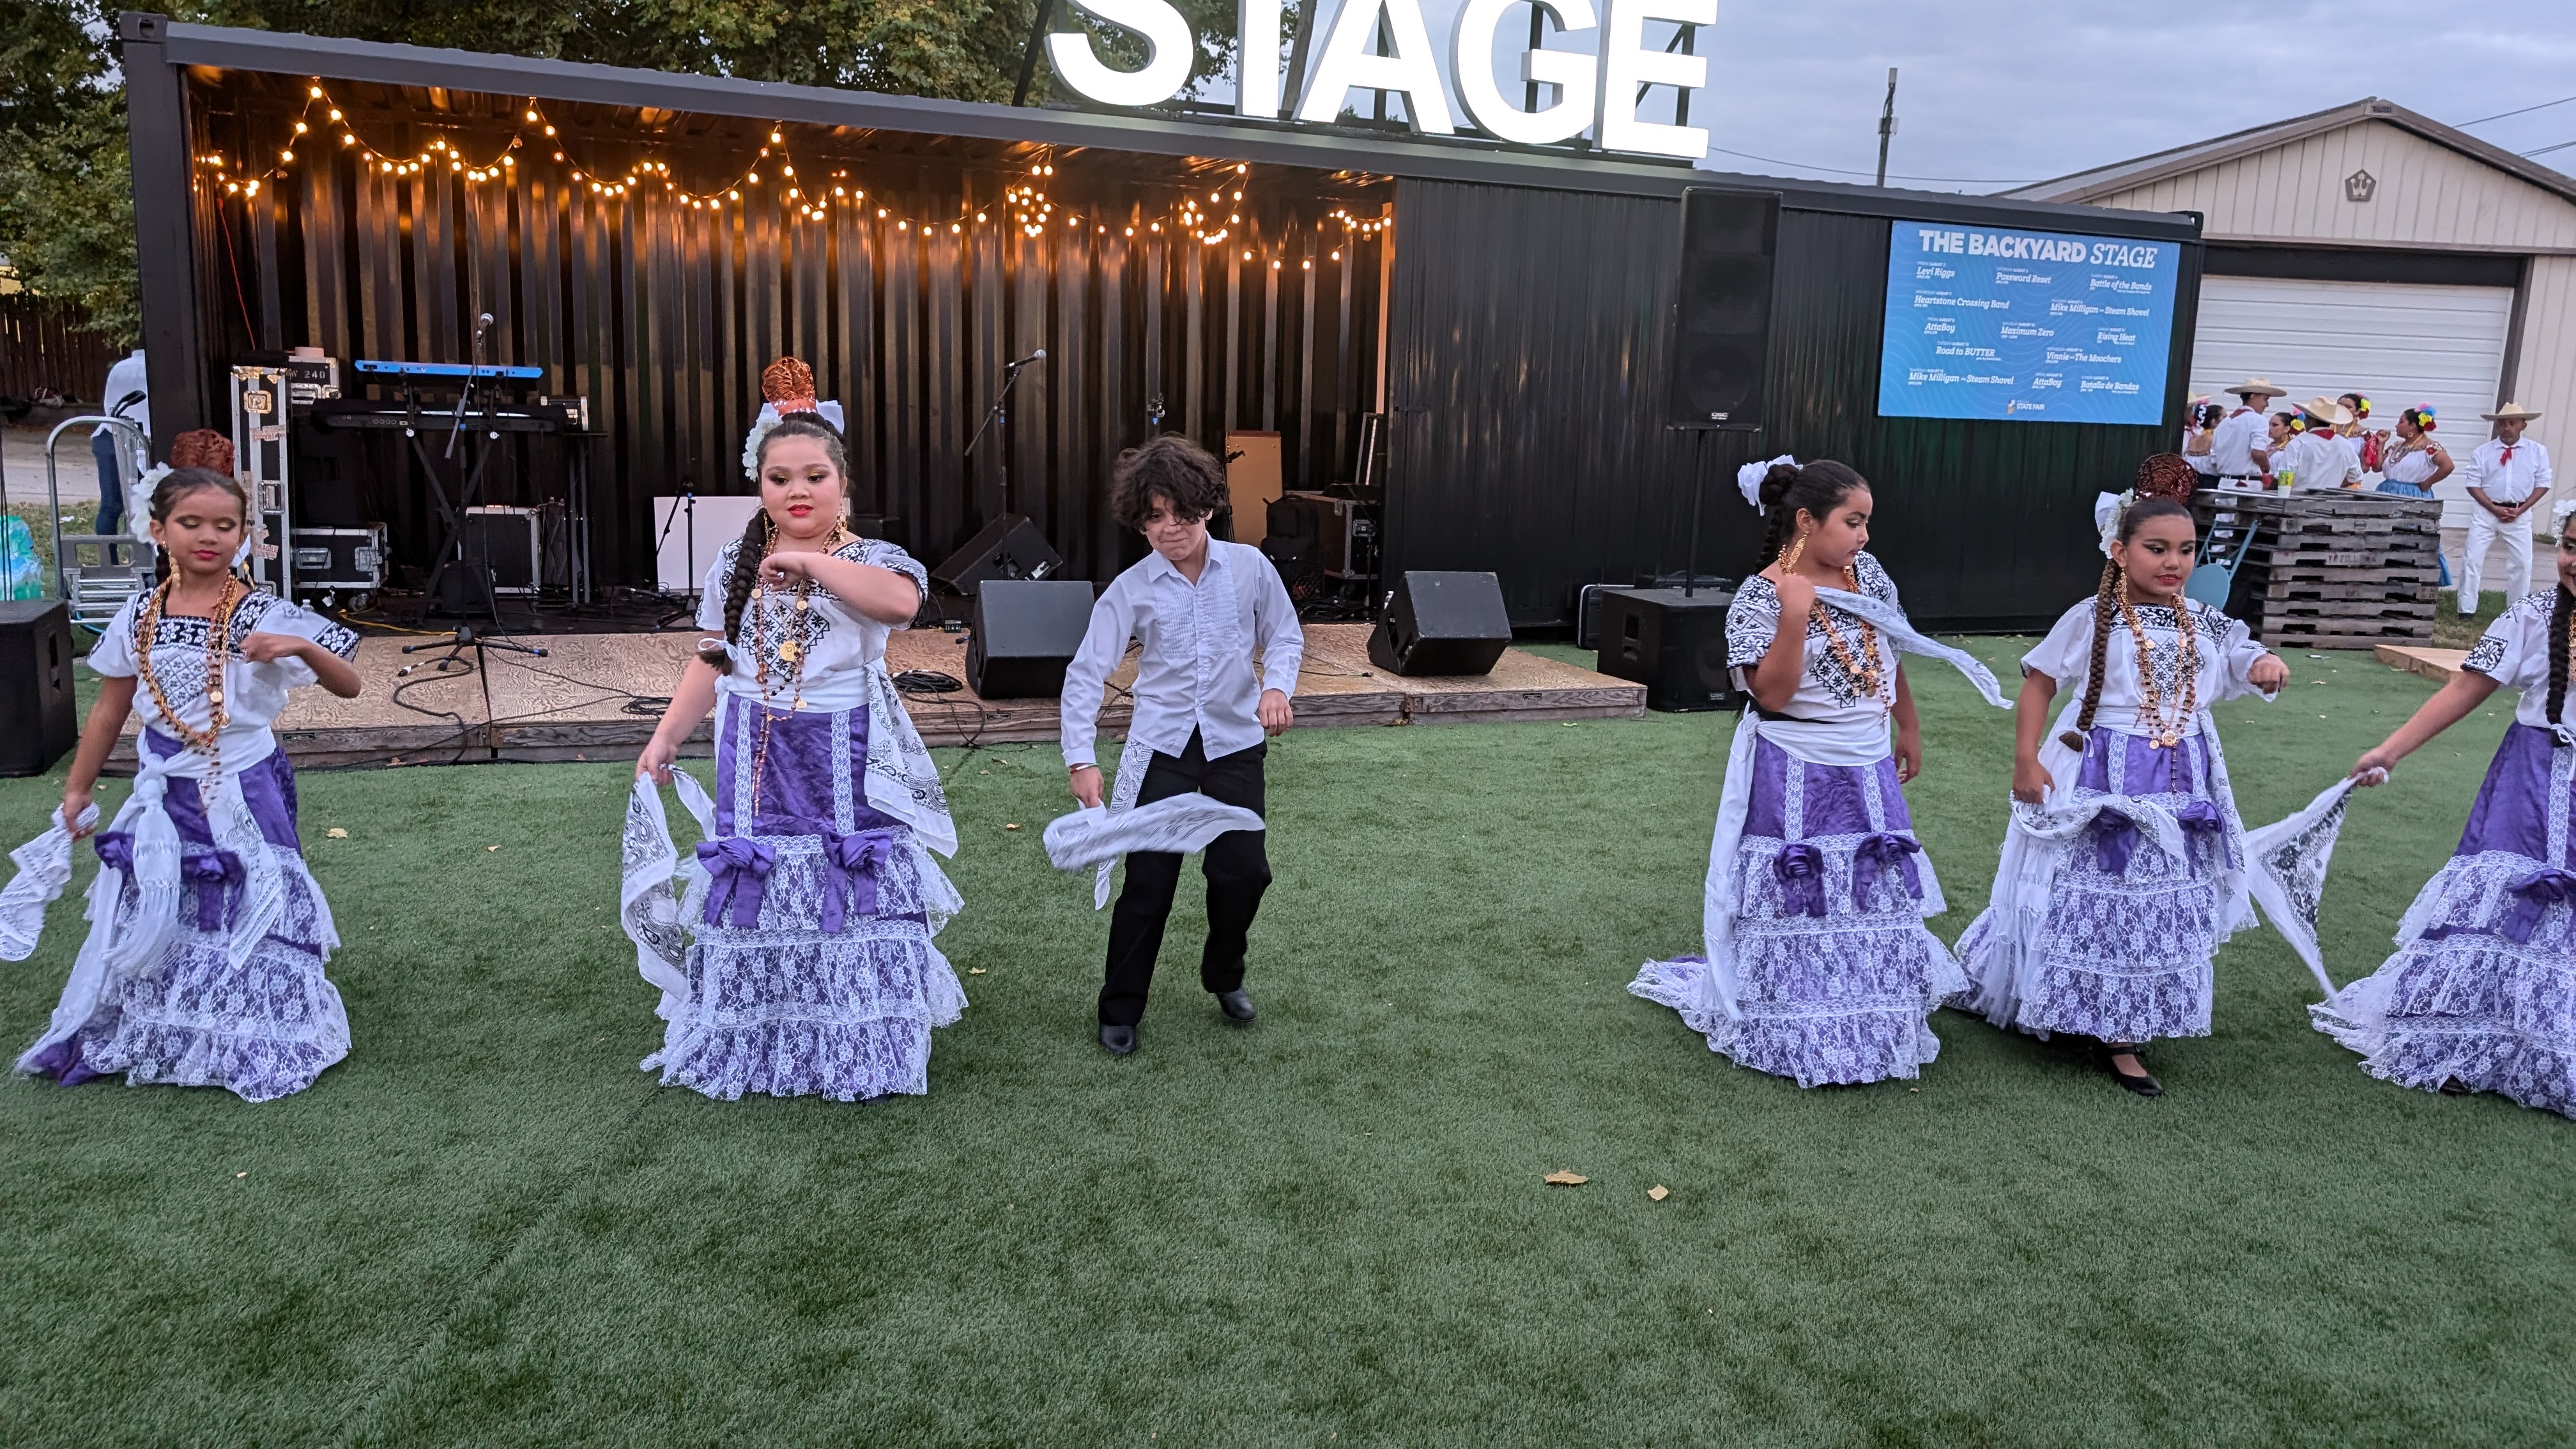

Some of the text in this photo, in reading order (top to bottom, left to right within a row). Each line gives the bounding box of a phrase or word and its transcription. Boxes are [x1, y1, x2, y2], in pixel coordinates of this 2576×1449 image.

[1046, 0, 1717, 159] STAGE
[1919, 229, 2158, 269] THE BACKYARD STAGE
[1916, 266, 1955, 279] Levi Riggs
[1996, 272, 2051, 284] Password Reset
[2090, 279, 2152, 291] Battle of the Bands
[1914, 295, 2010, 310] Heartstone Crossing Band
[2050, 302, 2069, 312] Mike
[2069, 303, 2099, 315] Milligan
[2104, 306, 2126, 315] Steam
[2126, 307, 2150, 317] Shovel
[1924, 322, 1956, 334] AttaBoy
[2000, 326, 2055, 337] Maximum Zero
[2096, 332, 2136, 342] Rising Heat
[1936, 346, 1956, 355] Road
[1964, 348, 1995, 357] BUTTER
[2046, 351, 2069, 360] Vinnie
[2074, 353, 2088, 362] The
[2089, 353, 2122, 363] Moochers
[304, 370, 326, 379] 240
[1908, 372, 1928, 381] Mike
[1928, 372, 1959, 384] Milligan
[1966, 374, 1989, 383] Steam
[1990, 376, 2014, 385] Shovel
[2033, 378, 2062, 388] AttaBoy
[2105, 381, 2113, 390] de
[2113, 382, 2140, 391] Bandas
